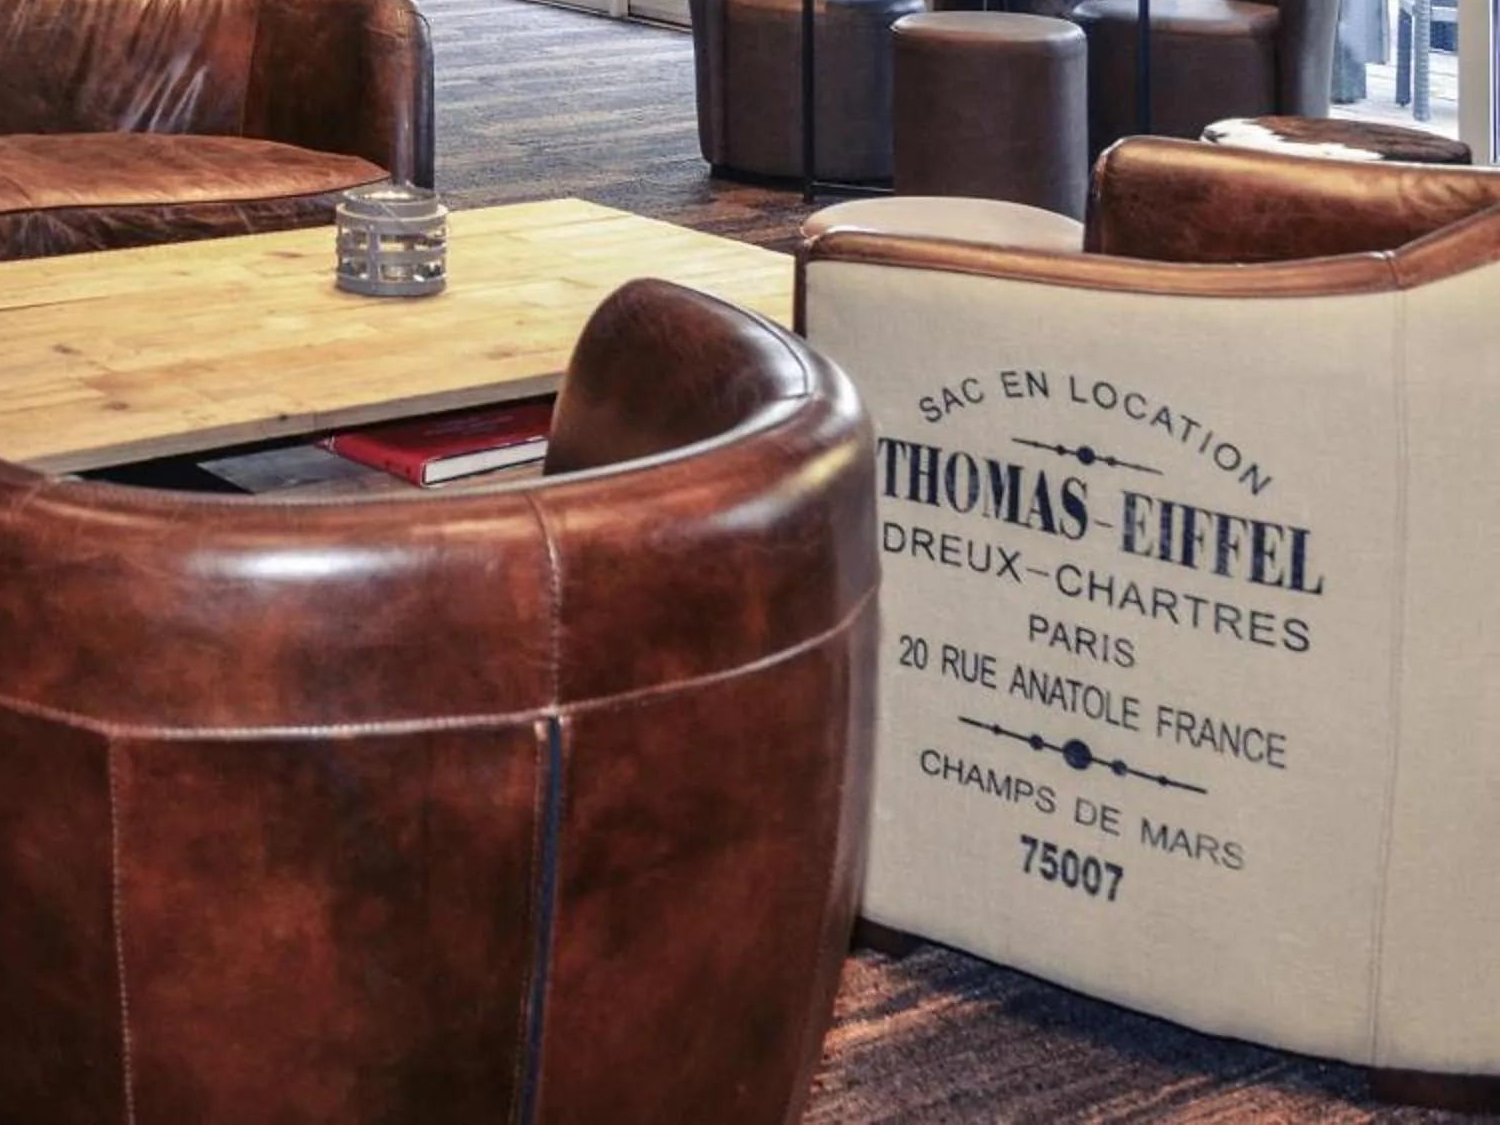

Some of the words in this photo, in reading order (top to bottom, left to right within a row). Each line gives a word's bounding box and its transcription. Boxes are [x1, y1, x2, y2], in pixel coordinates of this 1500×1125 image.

[918, 377, 985, 424] SAC
[1000, 370, 1050, 400] EN
[1069, 375, 1272, 497] LOCATION
[899, 635, 929, 671] 20
[941, 643, 997, 690] RUE
[1008, 664, 1140, 732] ANATOLE
[1156, 705, 1288, 769] FRANCE
[1028, 614, 1136, 669] PARIS
[919, 749, 1057, 815] CHAMPS
[1073, 797, 1121, 836] DE
[1140, 817, 1245, 871] MARS
[1019, 834, 1125, 902] 75007
